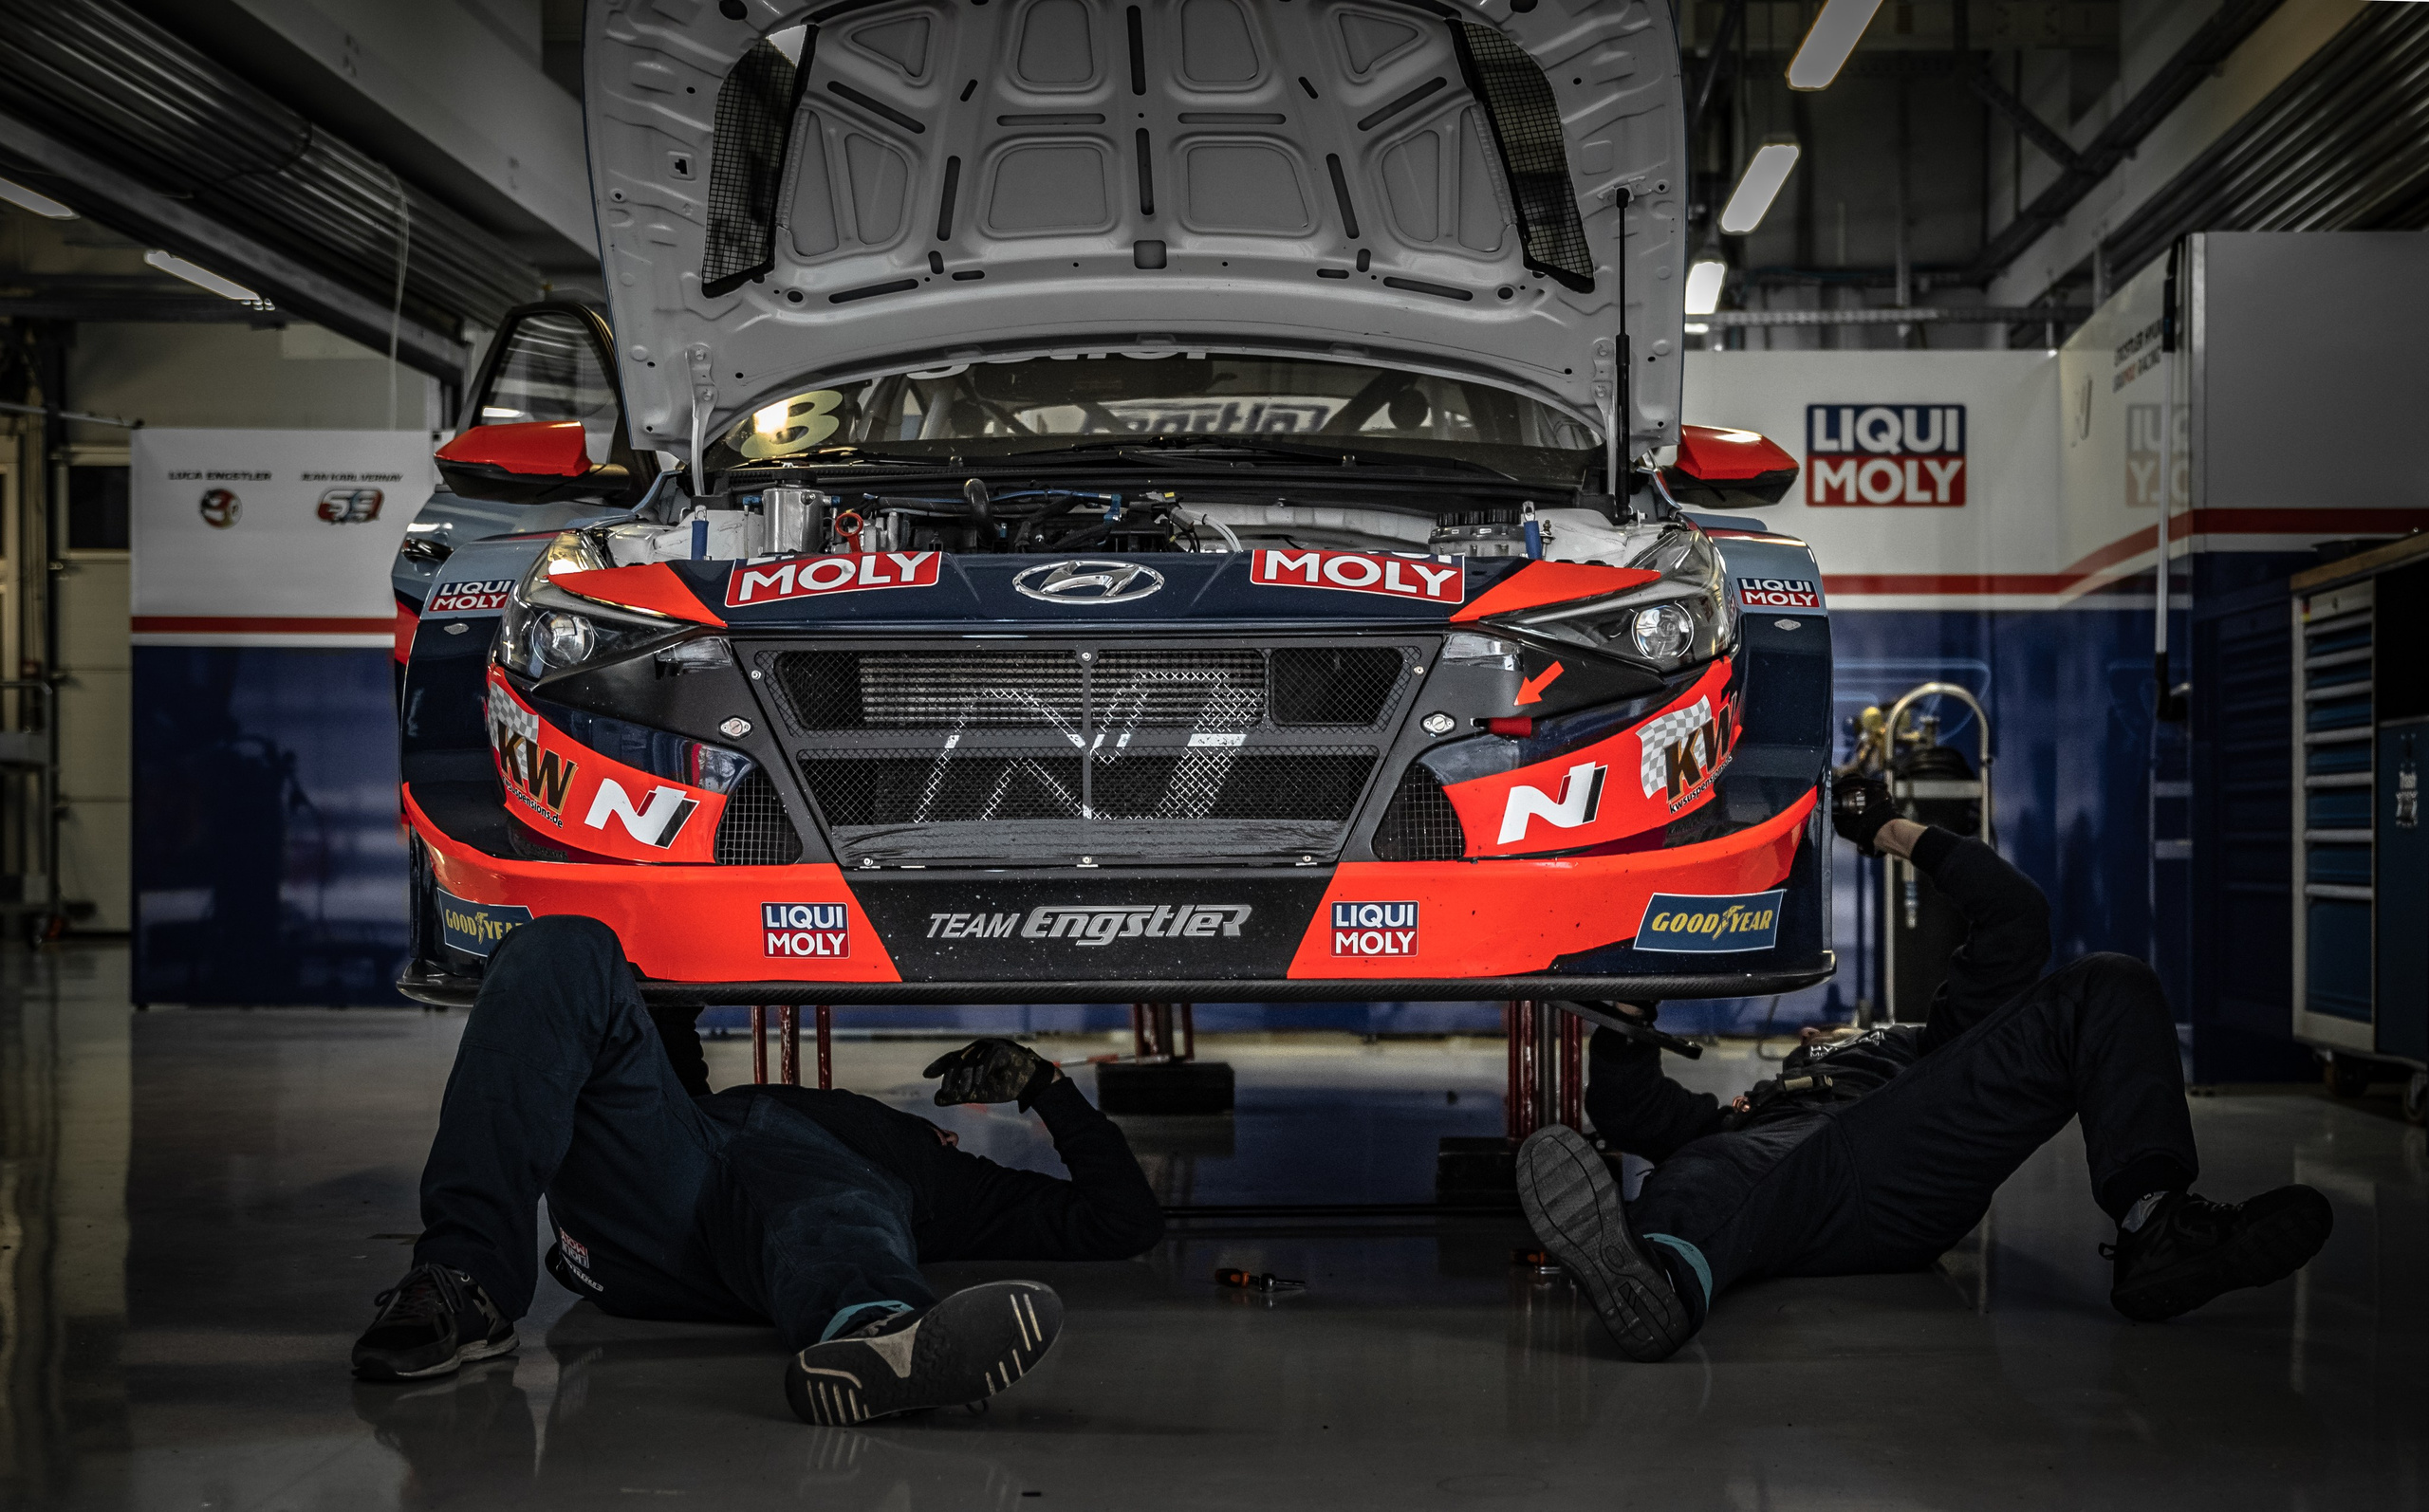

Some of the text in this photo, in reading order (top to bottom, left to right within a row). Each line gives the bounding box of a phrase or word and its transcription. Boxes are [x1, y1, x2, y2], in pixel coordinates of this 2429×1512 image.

[1813, 408, 1958, 454] LIQUI
[1813, 458, 1964, 505] MOLY
[739, 552, 934, 601] MOLY
[1264, 550, 1457, 597] MOLY
[440, 581, 511, 596] LIQUI
[1741, 579, 1811, 593] LIQUI
[433, 595, 507, 610] MOLY
[1745, 592, 1814, 606] MOLY
[497, 722, 579, 815] KW
[766, 906, 844, 929] LIQUI
[927, 913, 1020, 938] TEAM
[1336, 905, 1414, 929] LIQUI
[768, 933, 846, 956] MOLY
[1335, 931, 1416, 954] MOLY
